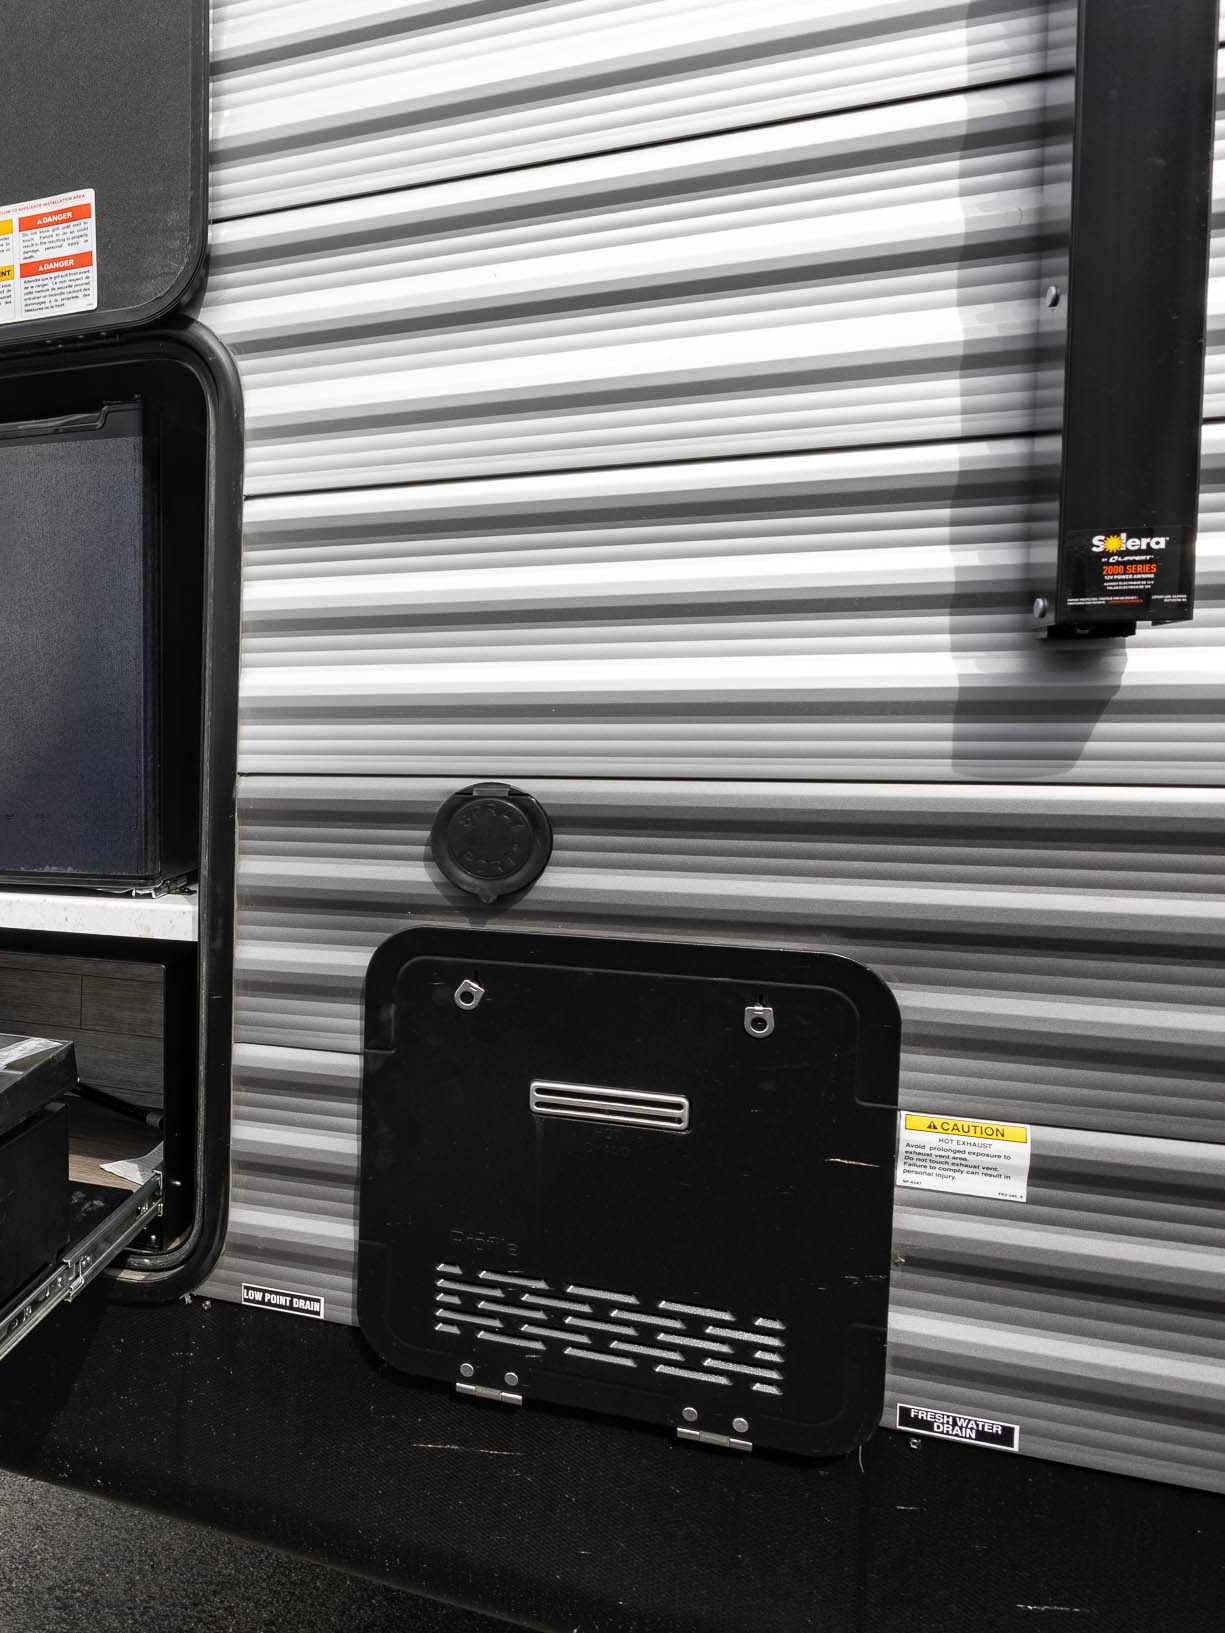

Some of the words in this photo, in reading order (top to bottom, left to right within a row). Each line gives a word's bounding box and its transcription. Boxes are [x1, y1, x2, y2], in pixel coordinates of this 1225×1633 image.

[43, 212, 72, 223] DANGER
[44, 259, 74, 270] DANGER
[1102, 565, 1124, 575] 2000
[1126, 564, 1157, 574] SERIES
[940, 1122, 1005, 1138] CAUTION
[906, 1142, 926, 1150] Avoid
[929, 1146, 966, 1155] prolonged
[968, 1150, 1002, 1159] exposure
[956, 1140, 992, 1149] EXHAUST
[244, 1288, 263, 1301] LOW
[264, 1293, 291, 1306] POINT
[293, 1298, 320, 1312] DRAIN
[910, 1408, 952, 1425] FRESH
[956, 1418, 1002, 1435] WATER
[933, 1422, 976, 1439] DRAIN
